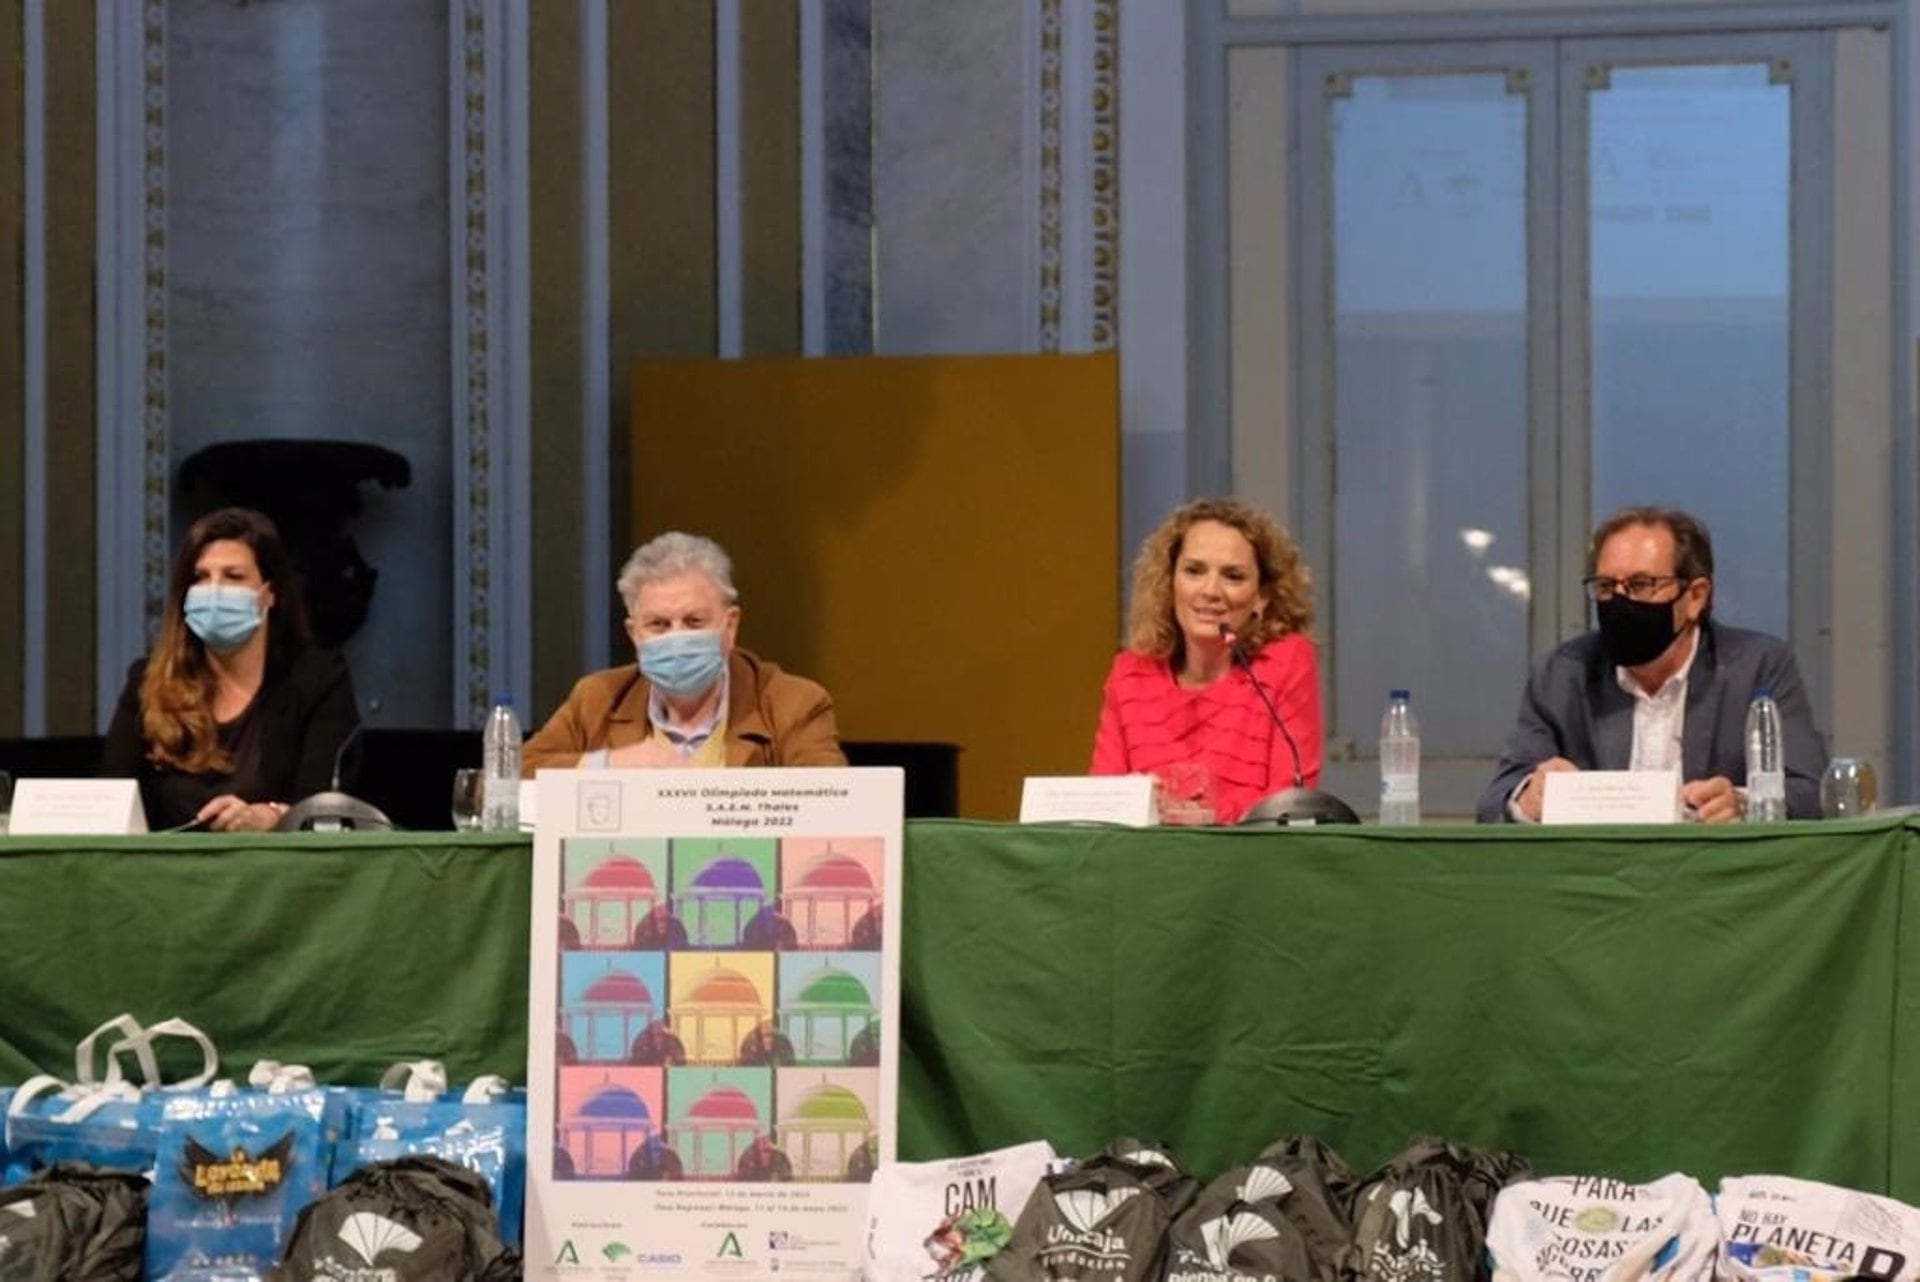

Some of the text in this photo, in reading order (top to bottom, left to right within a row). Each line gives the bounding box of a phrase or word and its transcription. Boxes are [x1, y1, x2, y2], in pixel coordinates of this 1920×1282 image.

[945, 1175, 997, 1218] CAM
[1572, 1176, 1636, 1202] PARA
[1047, 1223, 1126, 1254] Unicaja
[1731, 1223, 1856, 1264] PLANETA
[636, 1253, 682, 1264] CASIO
